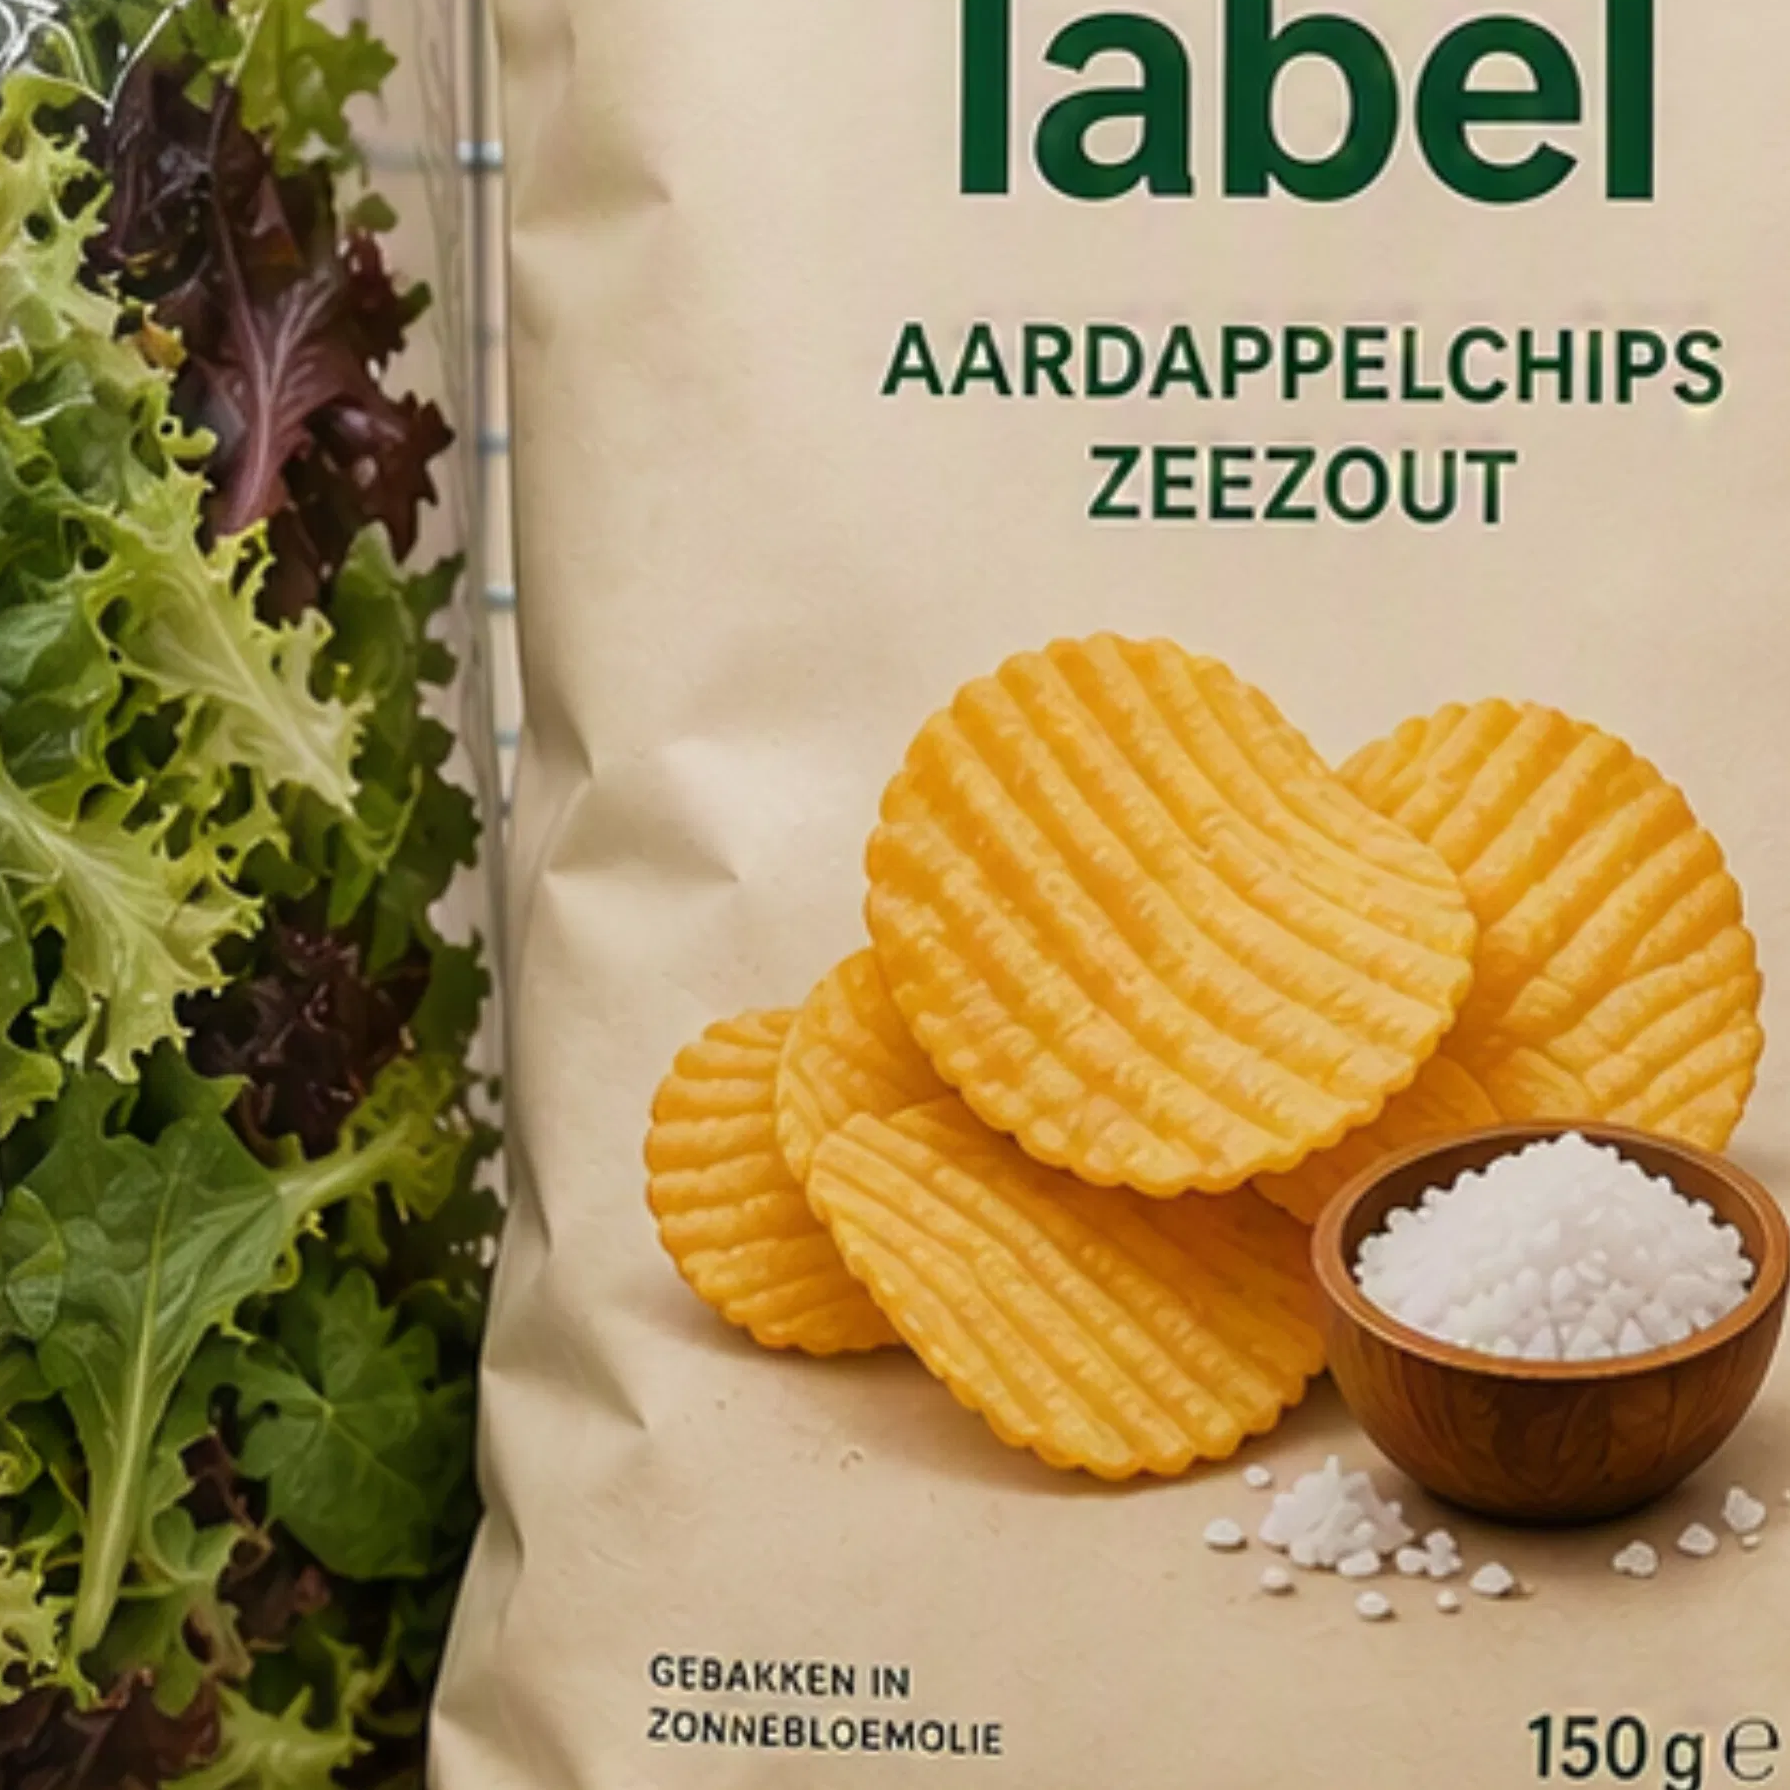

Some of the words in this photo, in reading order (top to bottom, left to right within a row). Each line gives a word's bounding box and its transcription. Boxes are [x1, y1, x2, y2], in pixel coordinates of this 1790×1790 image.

[881, 322, 1723, 405] AARDAPPELCHIPS
[1088, 445, 1518, 525] ZEEZOUT
[649, 1653, 856, 1698] GEBAKKEN
[871, 1666, 910, 1698] IN
[647, 1706, 1002, 1756] ZONNEBLOEMOLIE
